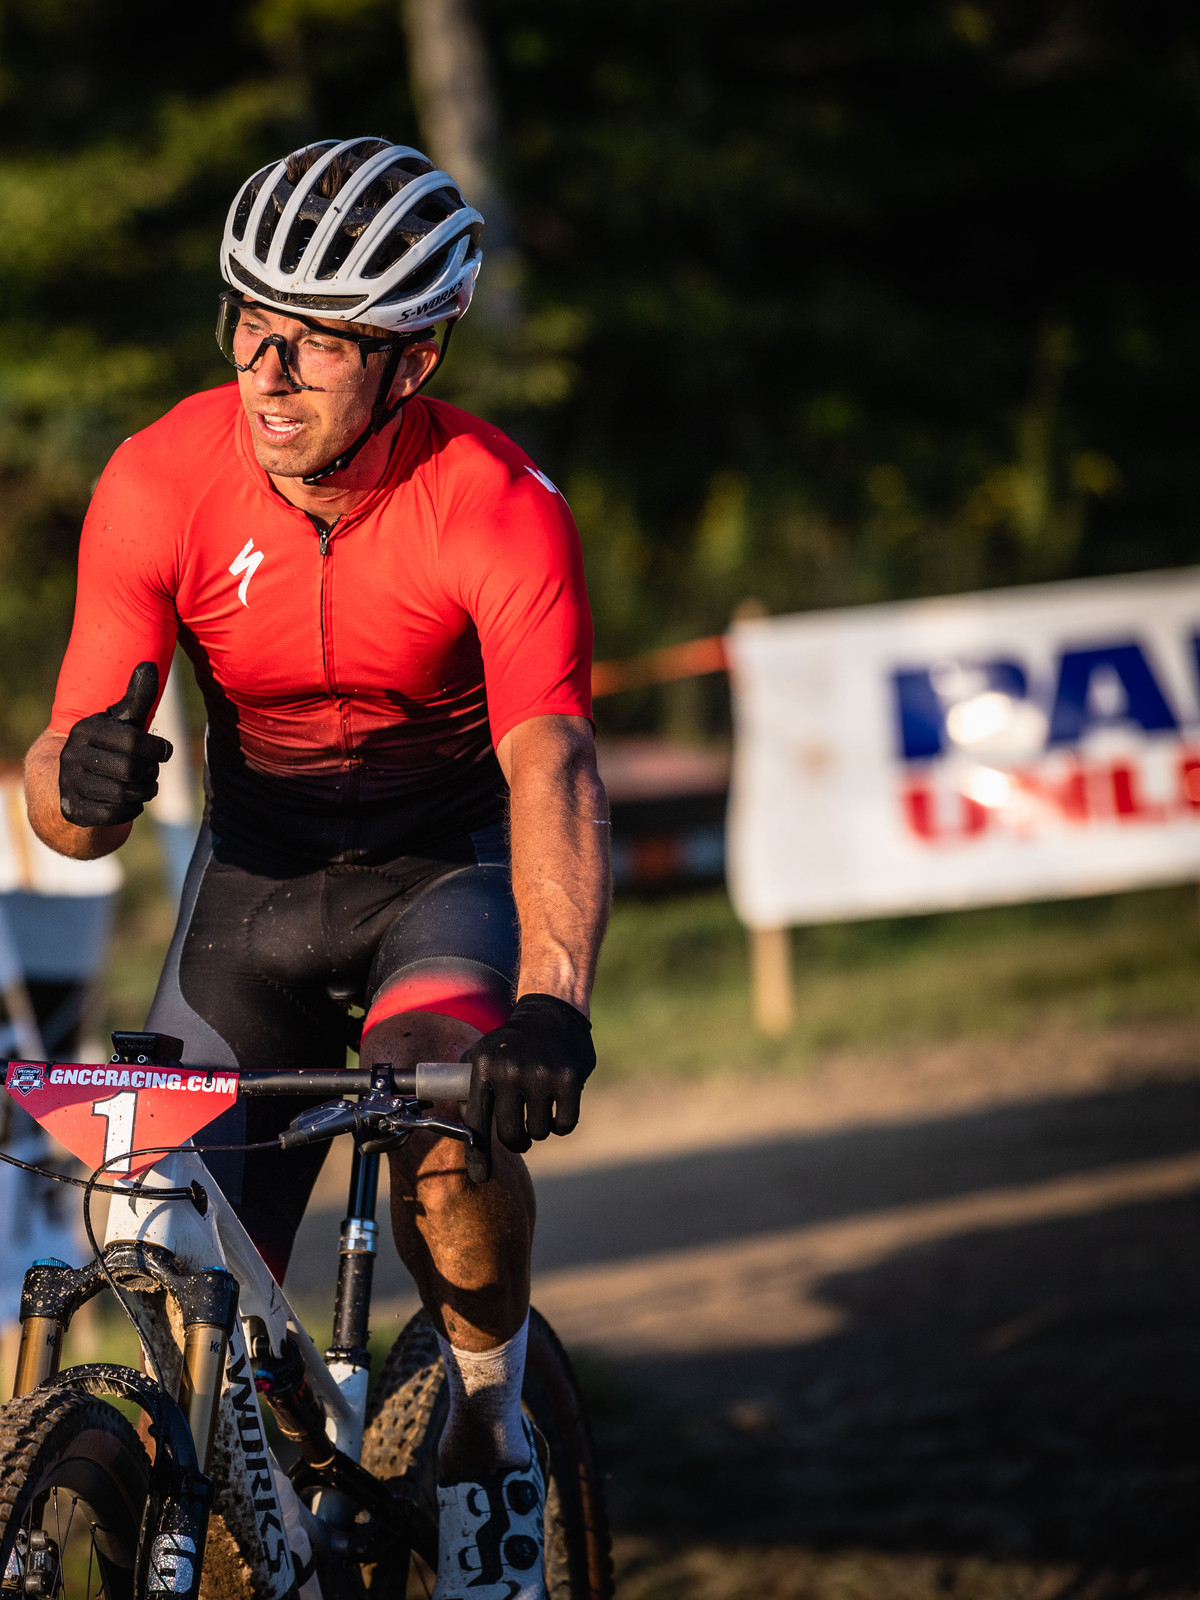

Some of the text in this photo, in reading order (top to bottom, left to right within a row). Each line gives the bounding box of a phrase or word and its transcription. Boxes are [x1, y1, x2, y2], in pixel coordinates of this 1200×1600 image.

[397, 278, 464, 322] S-WORKS
[50, 1068, 237, 1095] GNCCRACING.COM
[92, 1090, 138, 1174] 1
[225, 1325, 291, 1573] -WORKS
